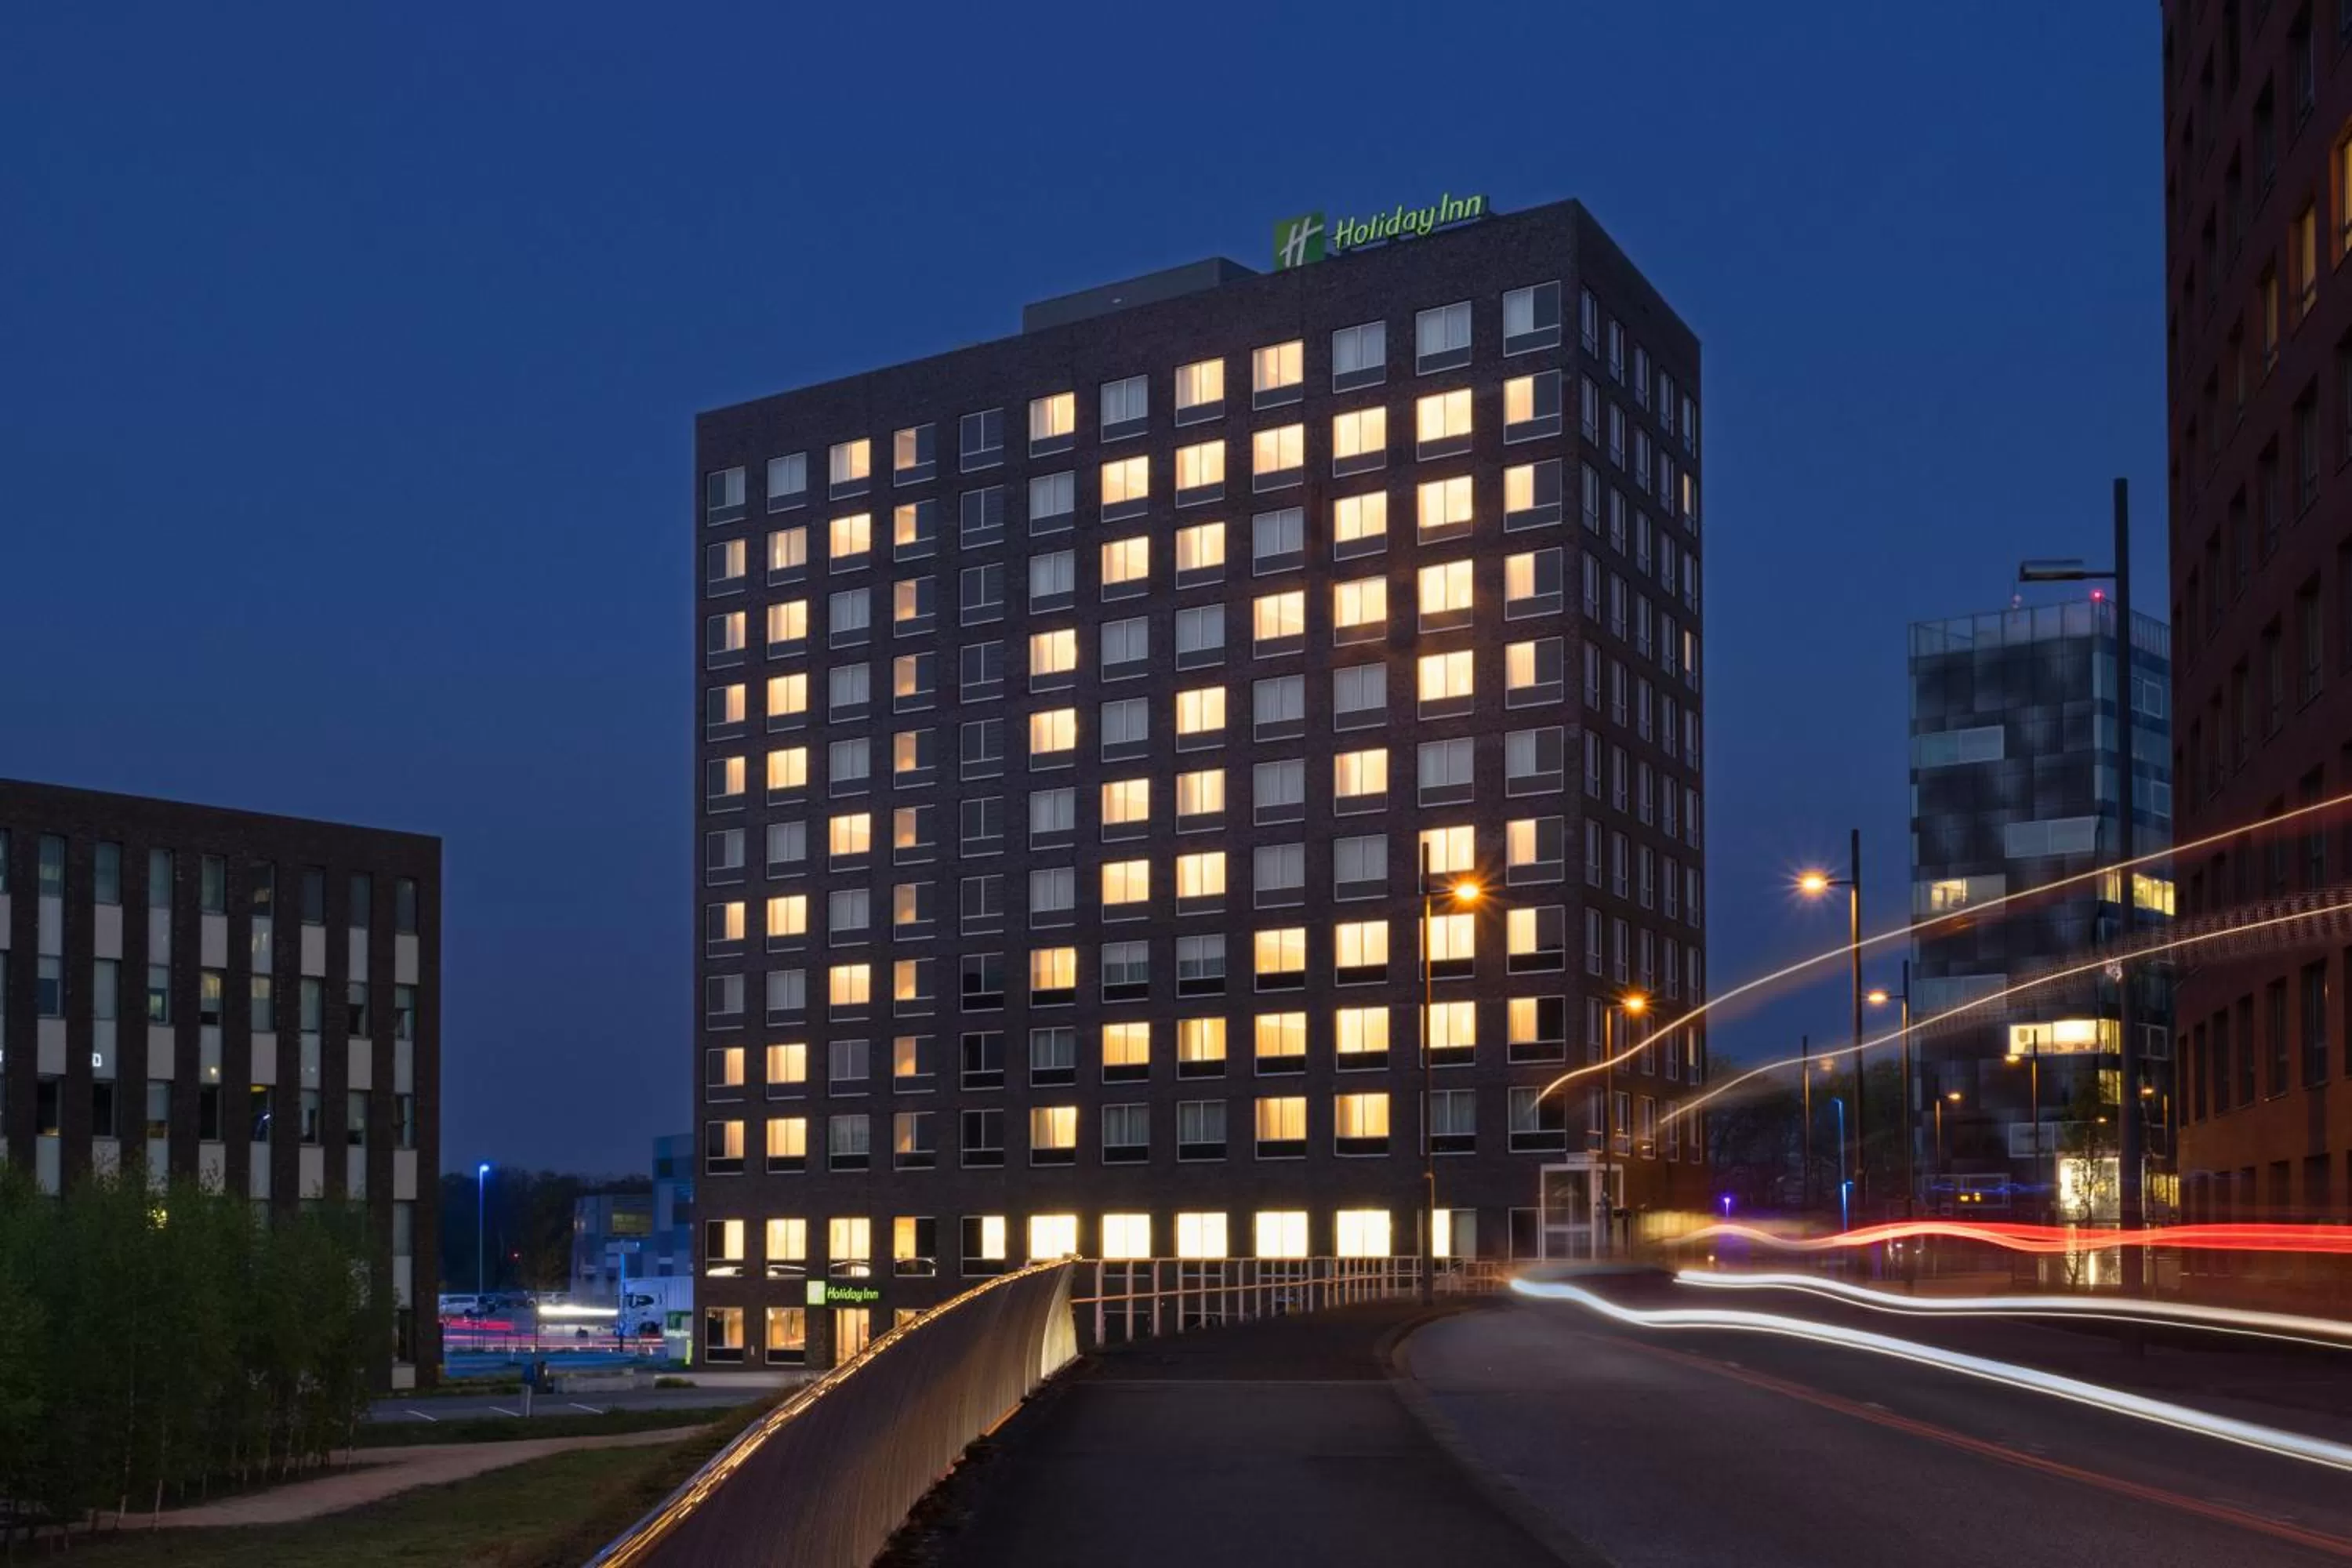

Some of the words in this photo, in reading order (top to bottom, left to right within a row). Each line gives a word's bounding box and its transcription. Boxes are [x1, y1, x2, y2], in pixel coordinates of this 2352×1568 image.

[1333, 205, 1436, 251] Holiday
[1439, 193, 1482, 222] Inn
[827, 1287, 862, 1301] Holiday
[863, 1287, 879, 1299] Inn
